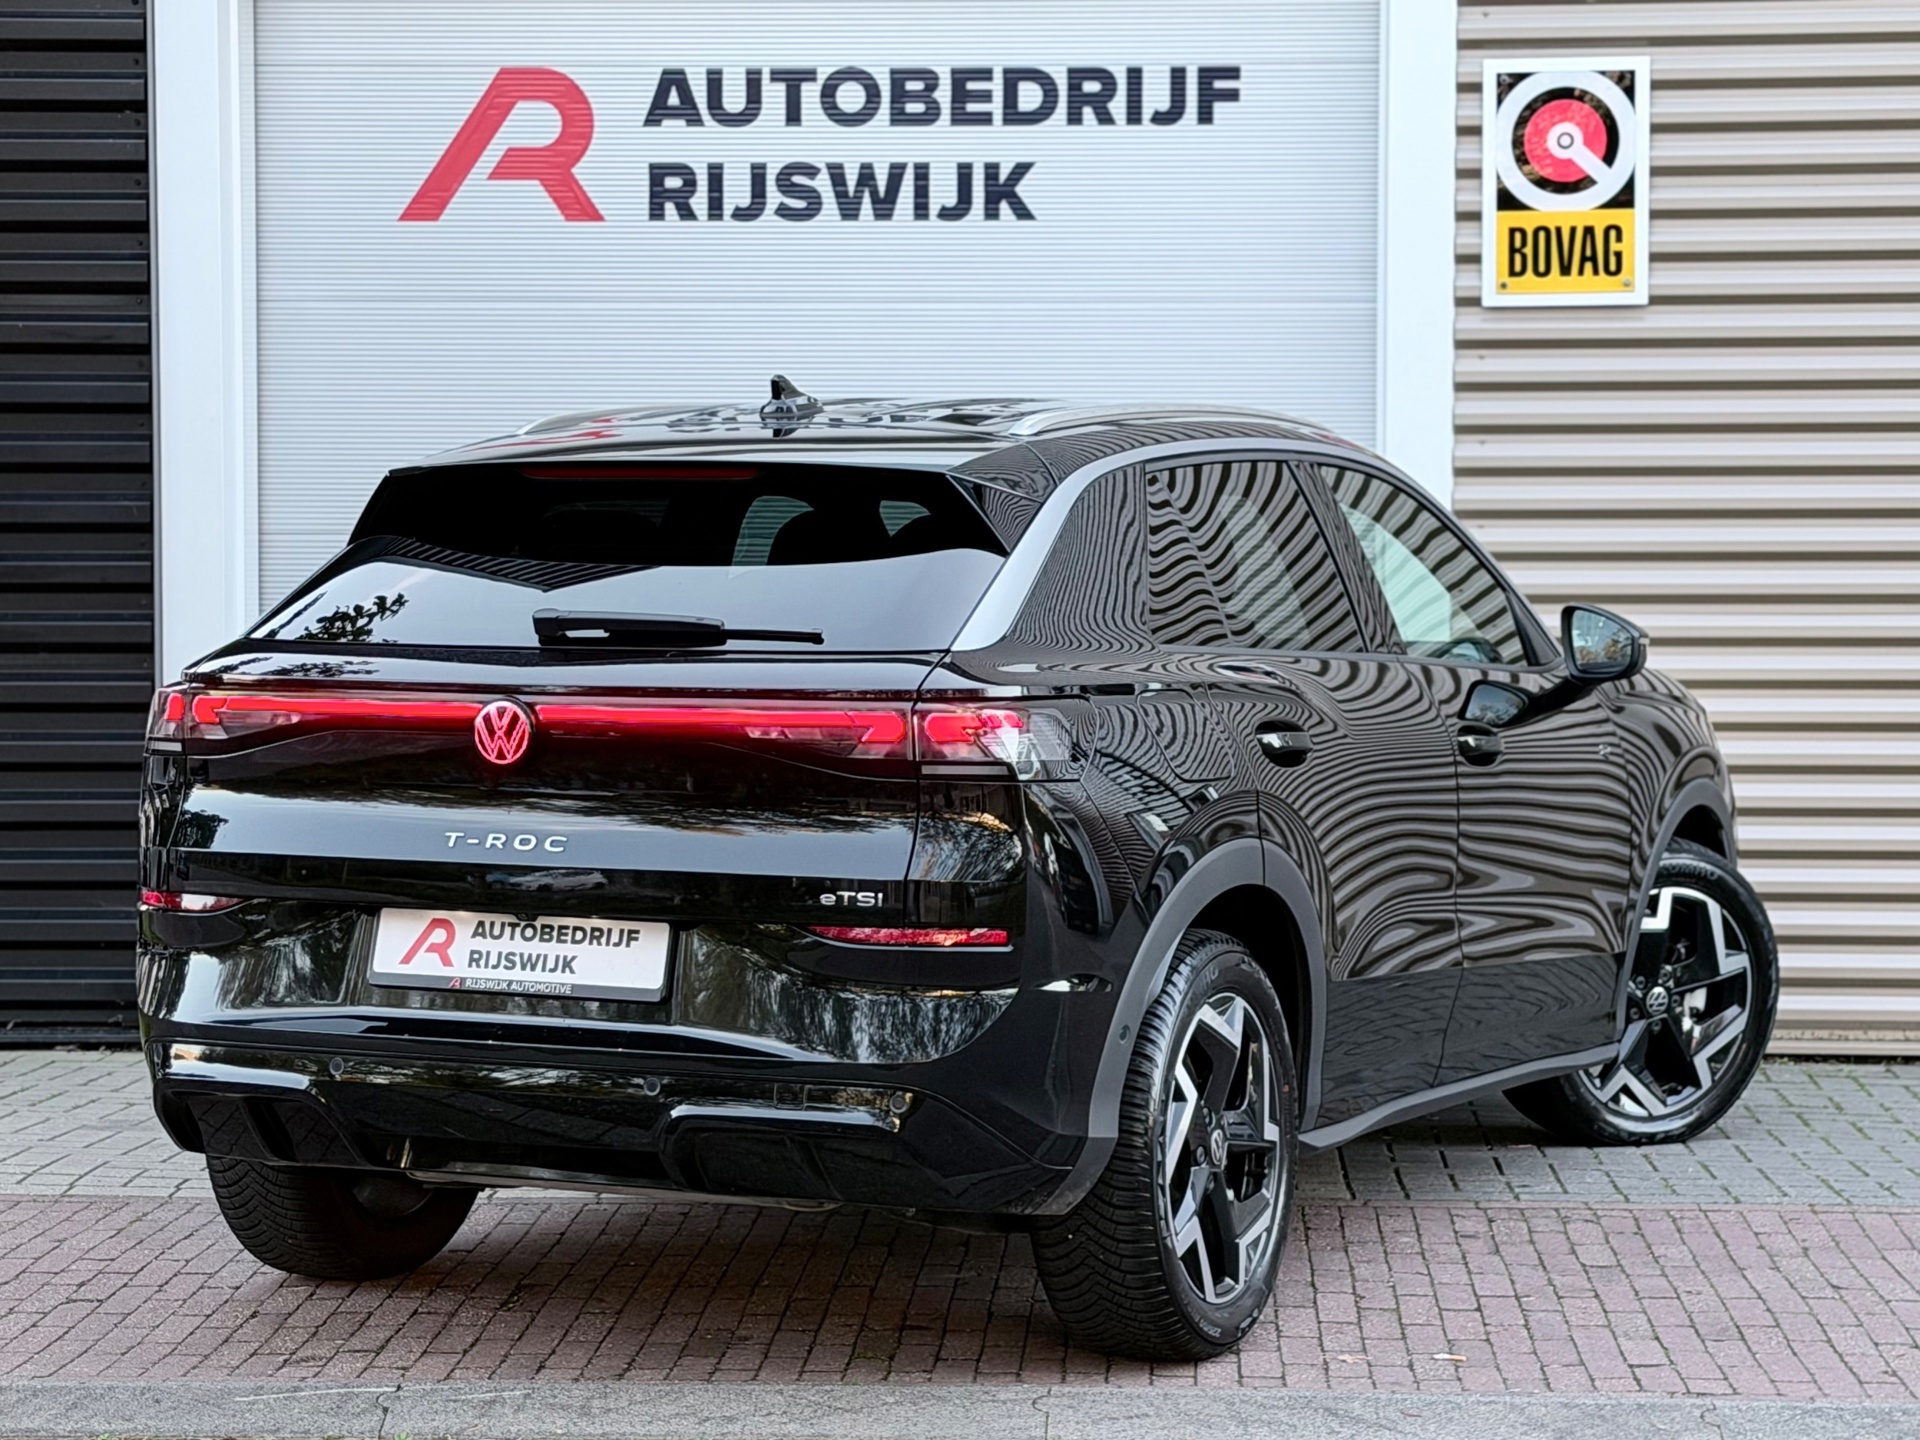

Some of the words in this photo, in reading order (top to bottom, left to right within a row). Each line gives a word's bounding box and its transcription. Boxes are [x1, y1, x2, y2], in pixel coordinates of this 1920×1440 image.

[642, 65, 1241, 127] AUTOBEDRIJF
[648, 161, 1037, 222] RIJSWIJK
[1508, 224, 1624, 278] BOVAG
[444, 832, 568, 852] T-ROC
[819, 891, 883, 907] eTSI
[470, 920, 641, 948] AUTOBEDRIJF
[467, 949, 579, 975] RIJSWIJK
[465, 978, 509, 990] RIJSWIJK
[510, 980, 573, 994] AUTOMOTIVE
